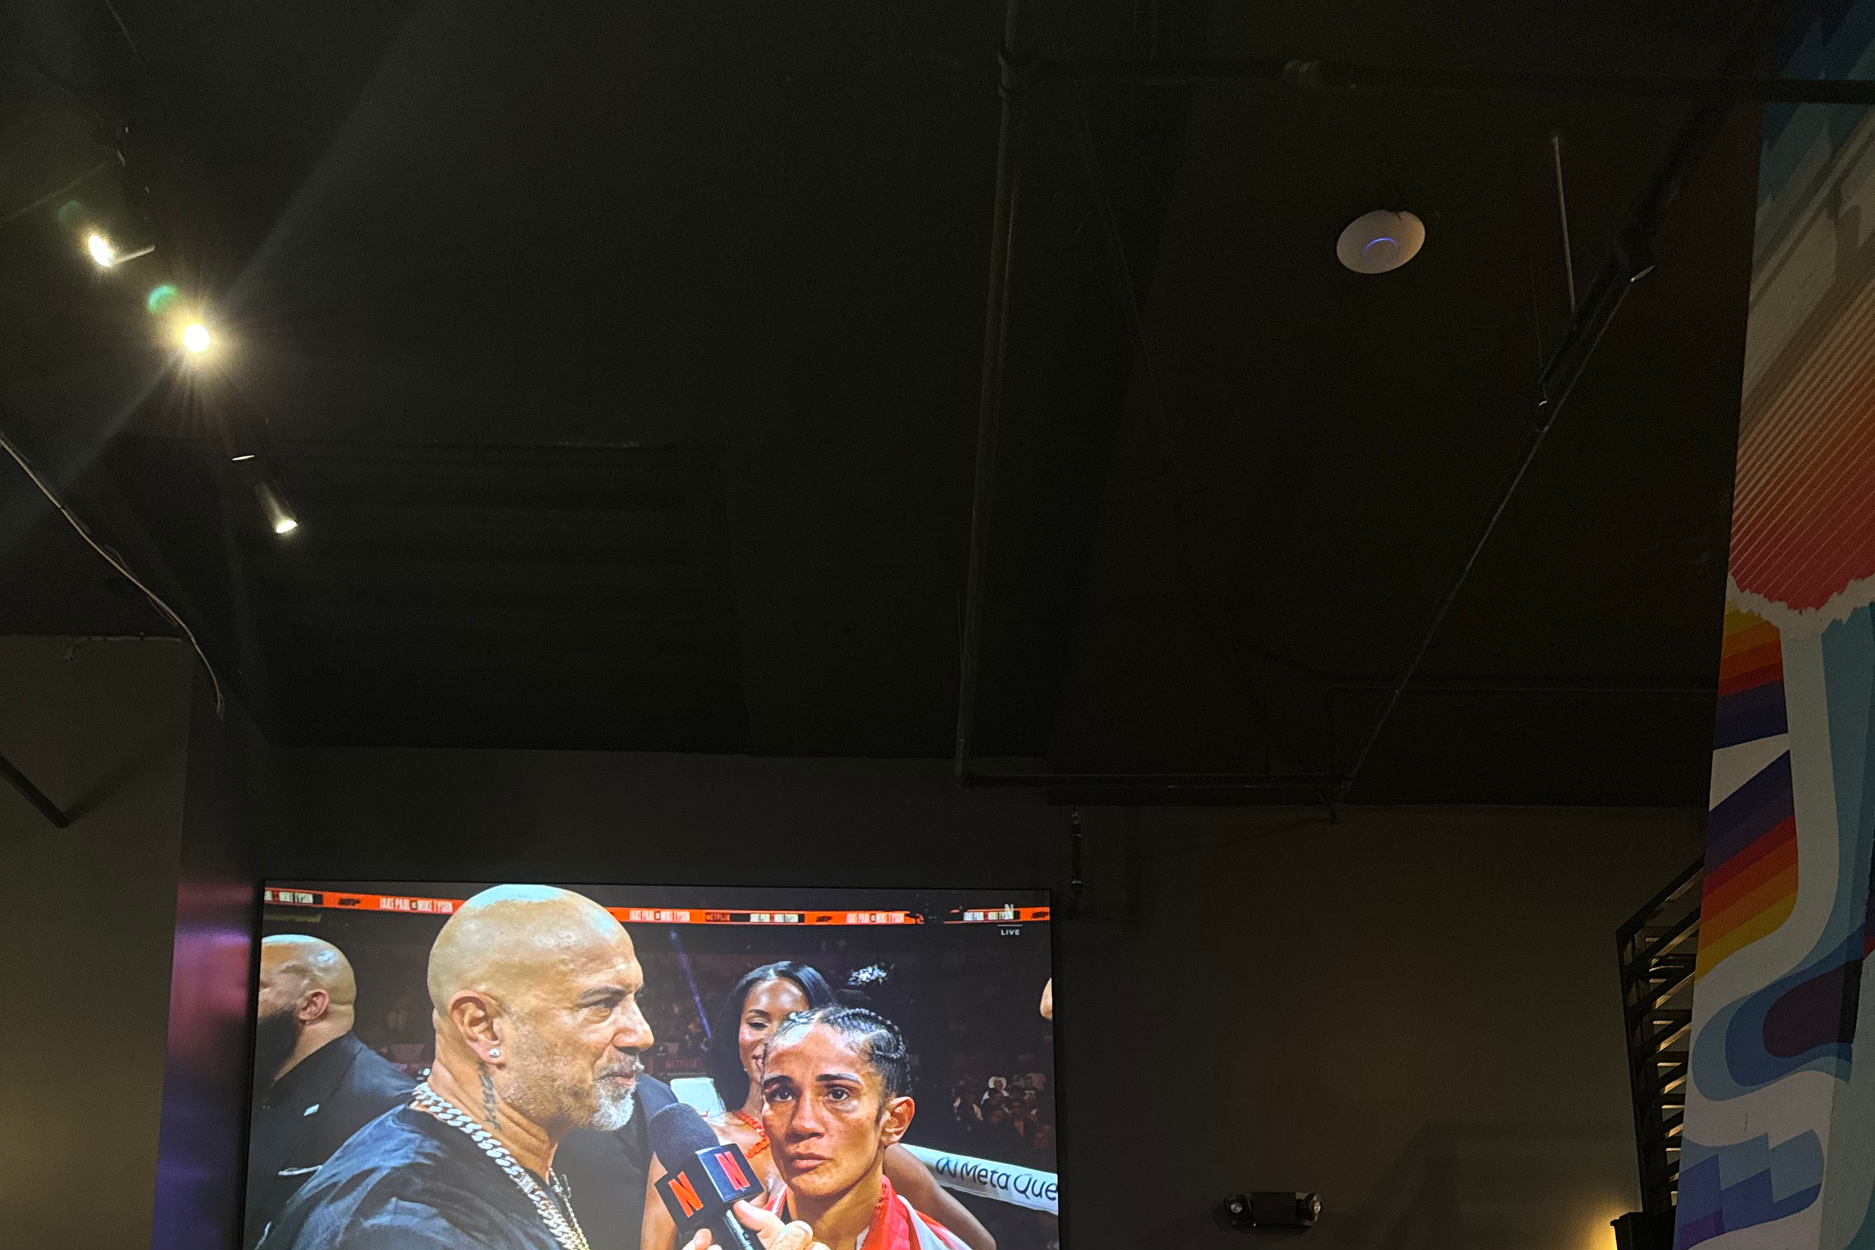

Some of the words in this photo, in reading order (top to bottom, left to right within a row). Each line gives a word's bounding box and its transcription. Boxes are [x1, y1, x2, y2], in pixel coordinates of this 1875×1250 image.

[714, 1151, 751, 1191] N
[960, 1162, 1011, 1191] Meta
[668, 1171, 704, 1218] N
